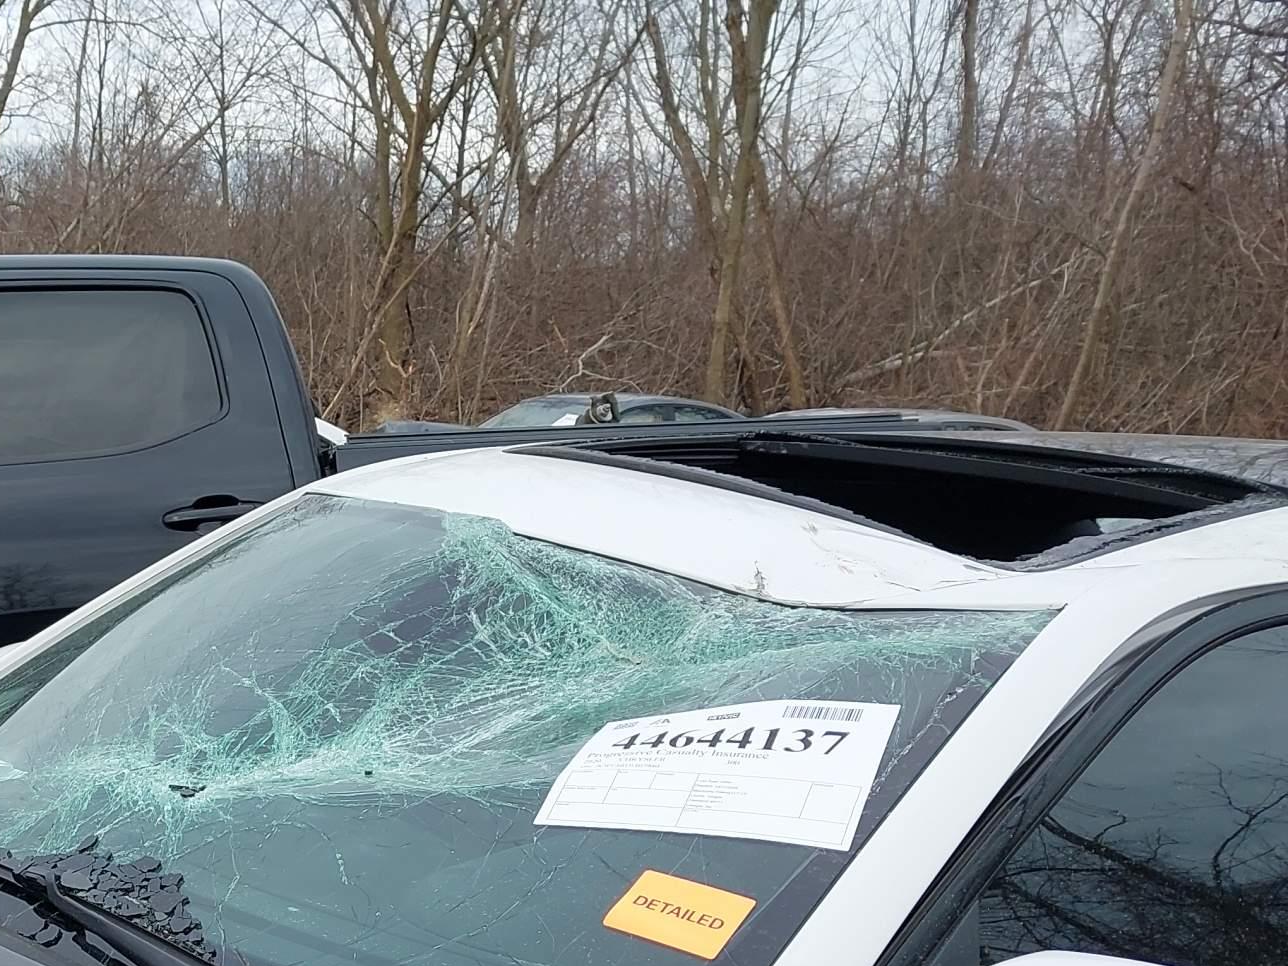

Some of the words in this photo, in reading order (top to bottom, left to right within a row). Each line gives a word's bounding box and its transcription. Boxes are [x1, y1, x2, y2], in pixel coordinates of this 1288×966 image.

[611, 726, 850, 755] 44644137
[656, 749, 708, 759] Casualty
[711, 749, 769, 760] Insurance
[633, 895, 725, 930] DETAILED
